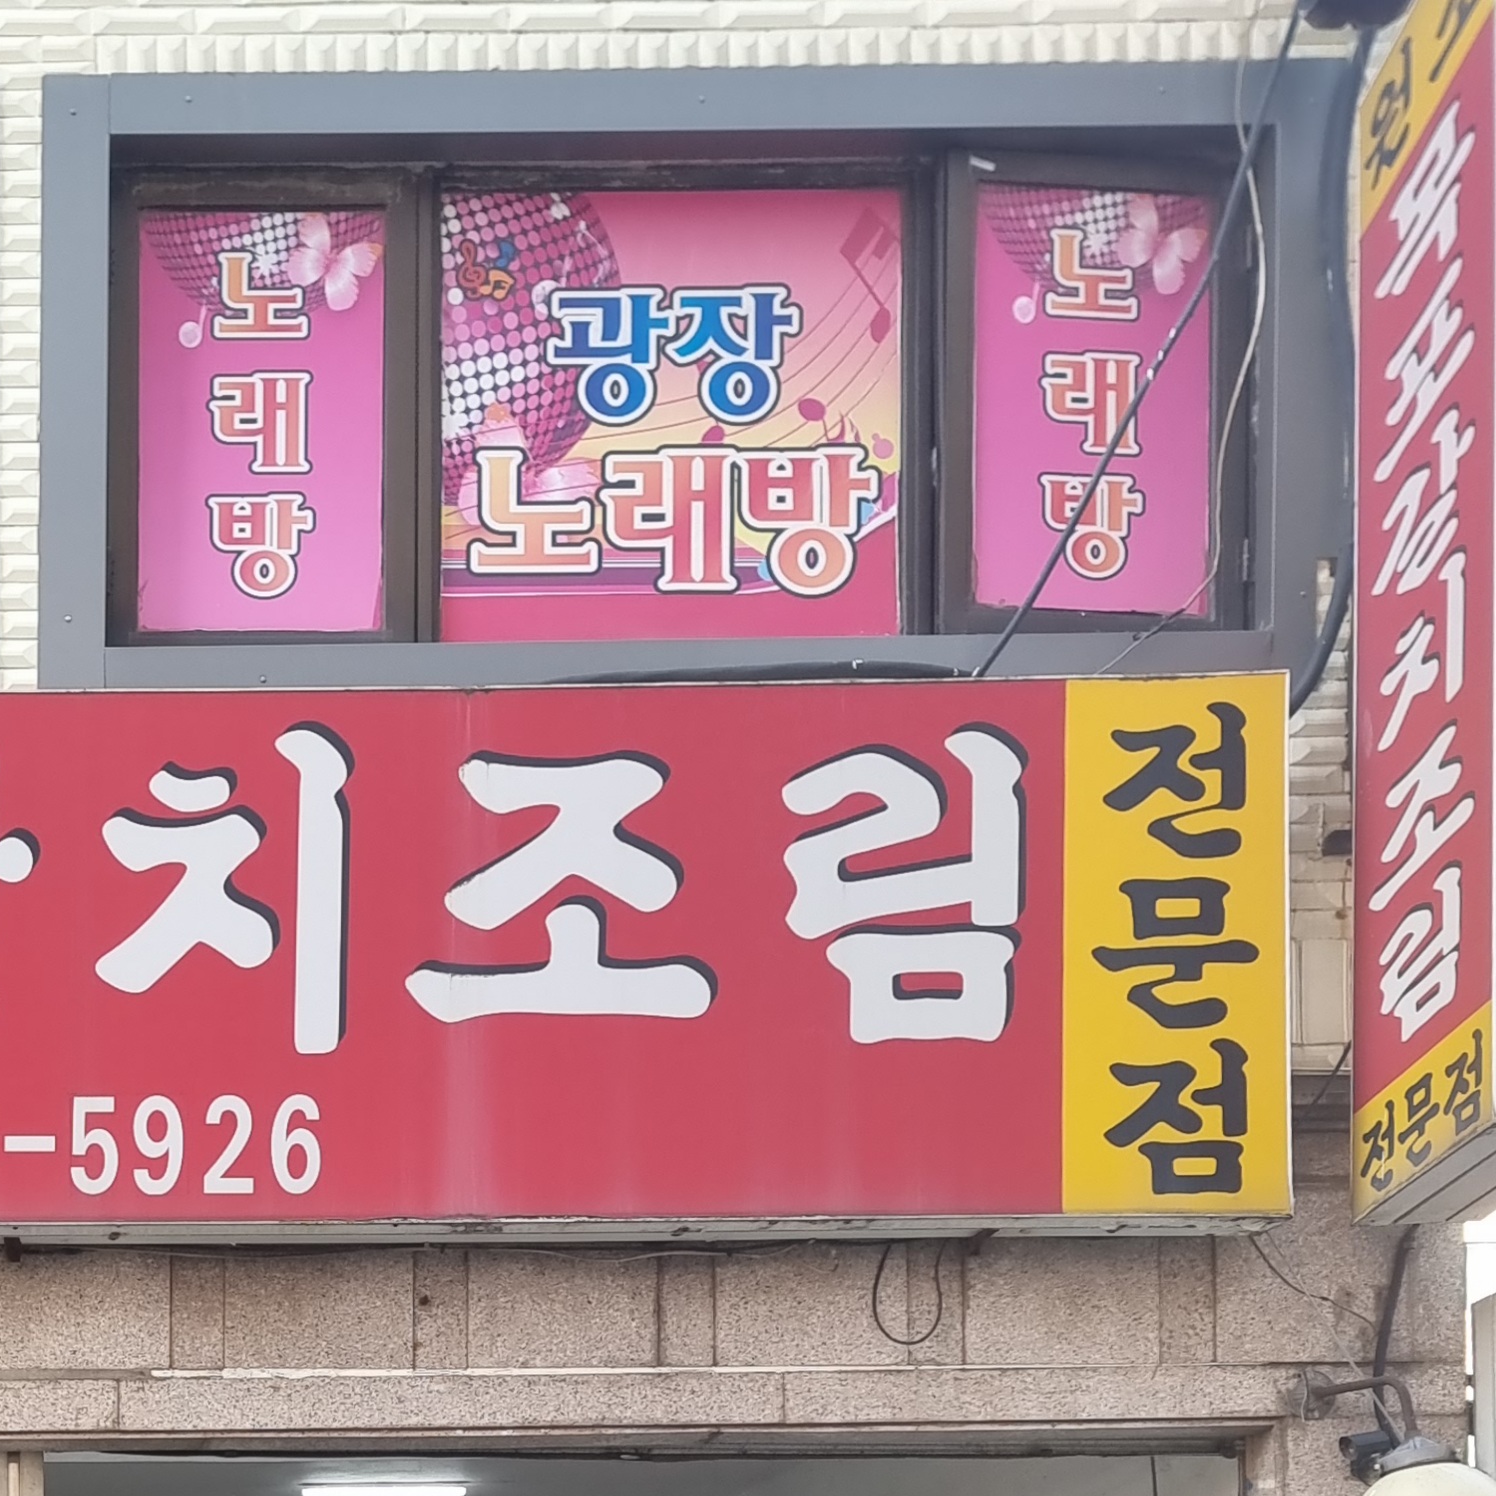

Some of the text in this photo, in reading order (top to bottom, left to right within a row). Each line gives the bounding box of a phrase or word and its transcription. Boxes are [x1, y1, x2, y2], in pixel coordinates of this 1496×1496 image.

[205, 250, 316, 599] 노래방
[466, 444, 882, 597] 노래방
[546, 283, 801, 426] 광장
[1038, 229, 1144, 580] 노래방
[1368, 100, 1476, 1043] 목포갈치조림
[1092, 702, 1260, 1195] 전문점
[1361, 1029, 1483, 1191] 전문점
